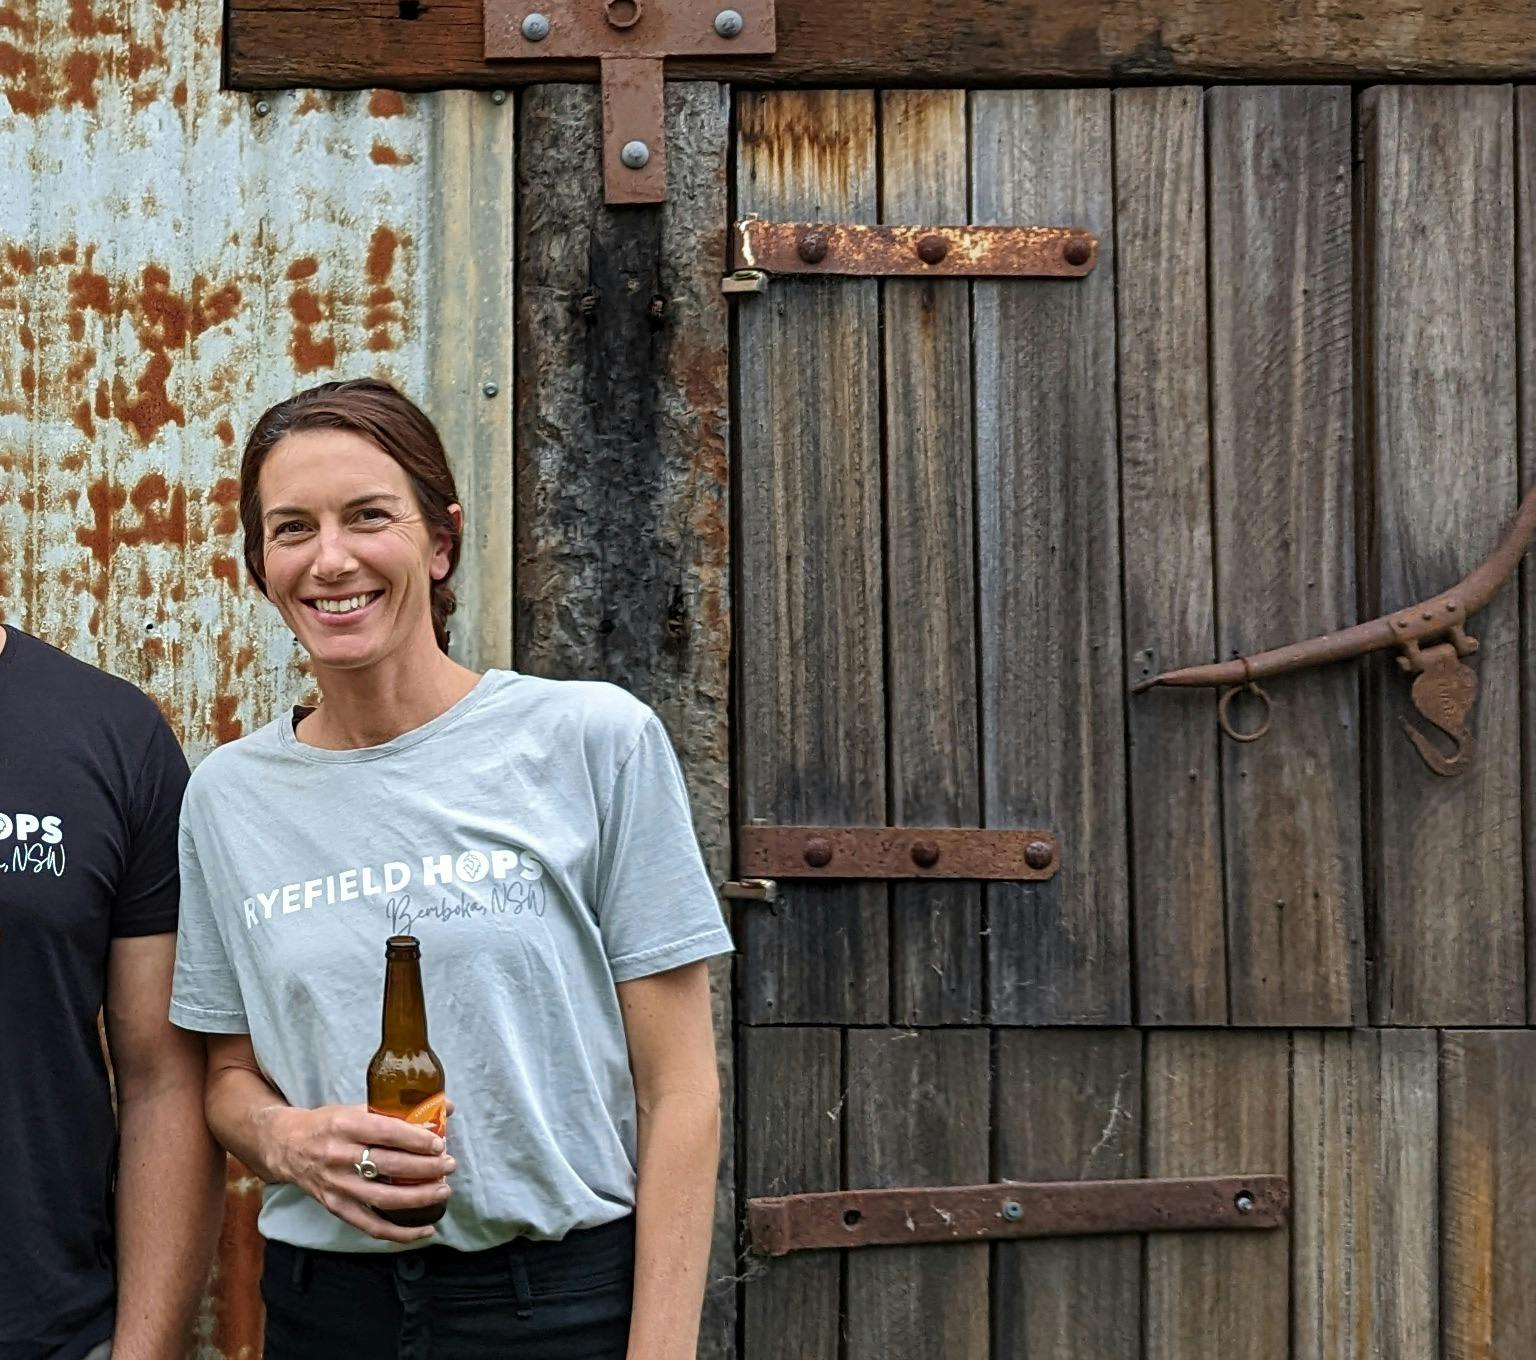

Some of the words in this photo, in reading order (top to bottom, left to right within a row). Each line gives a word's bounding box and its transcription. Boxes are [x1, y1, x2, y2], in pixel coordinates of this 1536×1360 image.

[12, 843, 66, 878] NSW
[243, 861, 412, 930] RYEFIELD
[422, 849, 544, 886] HOPS
[386, 893, 487, 935] Bemboka,
[491, 881, 546, 918] NSW
